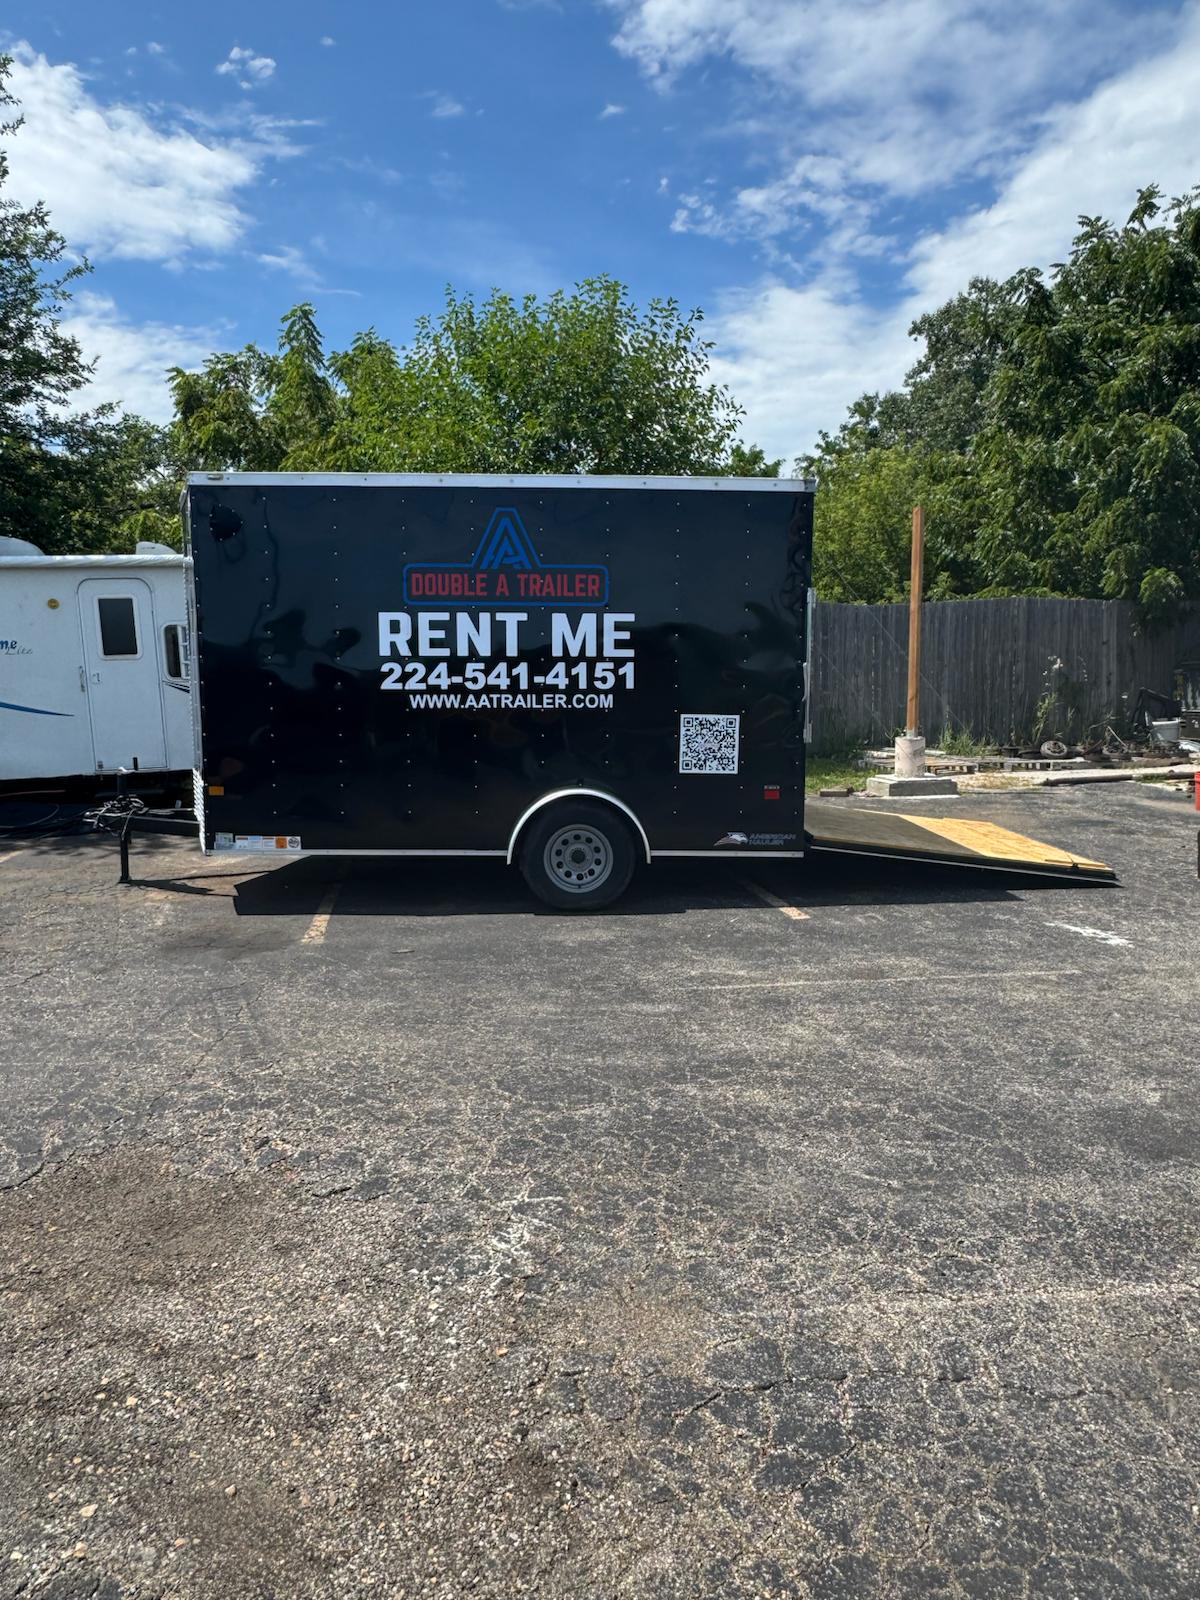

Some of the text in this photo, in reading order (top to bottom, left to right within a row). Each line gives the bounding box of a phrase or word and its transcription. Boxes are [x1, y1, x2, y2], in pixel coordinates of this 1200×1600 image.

[411, 573, 600, 597] DOUBLE A TRAILER
[378, 612, 635, 657] RENT ME
[380, 662, 635, 690] 224-541-4151
[409, 694, 614, 709] WWW.AATRAILER.COM
